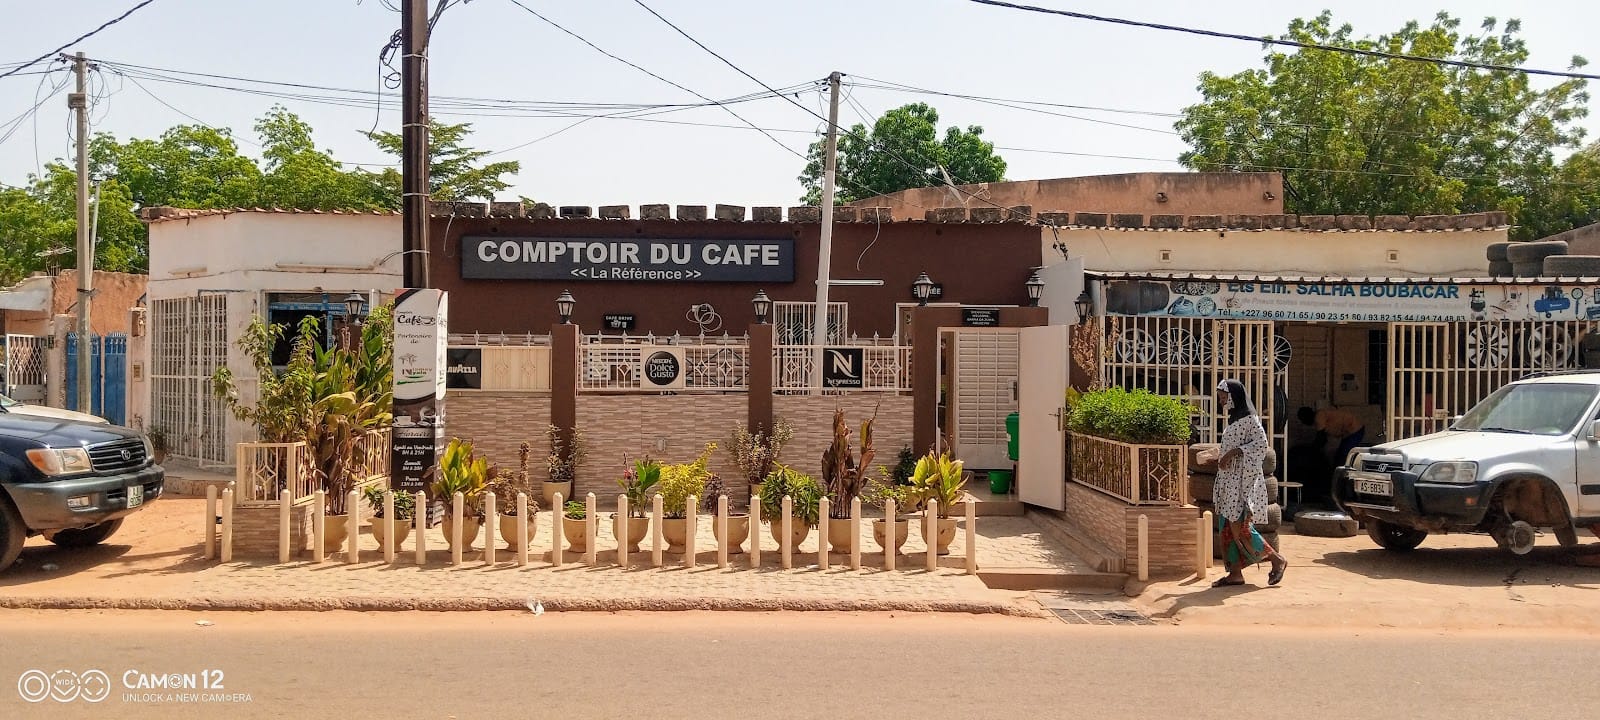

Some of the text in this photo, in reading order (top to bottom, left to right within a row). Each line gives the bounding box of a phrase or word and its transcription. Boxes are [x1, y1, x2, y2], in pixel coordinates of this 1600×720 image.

[477, 240, 780, 266] COMPTOIR DU CAFE
[591, 266, 607, 279] La
[611, 266, 682, 280] Référence
[1296, 284, 1356, 297] SALHA
[1359, 285, 1459, 299] BOUBACAR
[1241, 309, 1260, 317] +227
[1262, 310, 1273, 318] 96
[1274, 310, 1285, 318] 60
[1287, 311, 1296, 319] 71
[1315, 312, 1326, 320] 90
[1328, 312, 1338, 320] 23
[447, 364, 477, 373] AVAZZA
[650, 363, 675, 371] Dolce
[650, 370, 675, 378] Gusto
[825, 377, 861, 387] NESPRESSO
